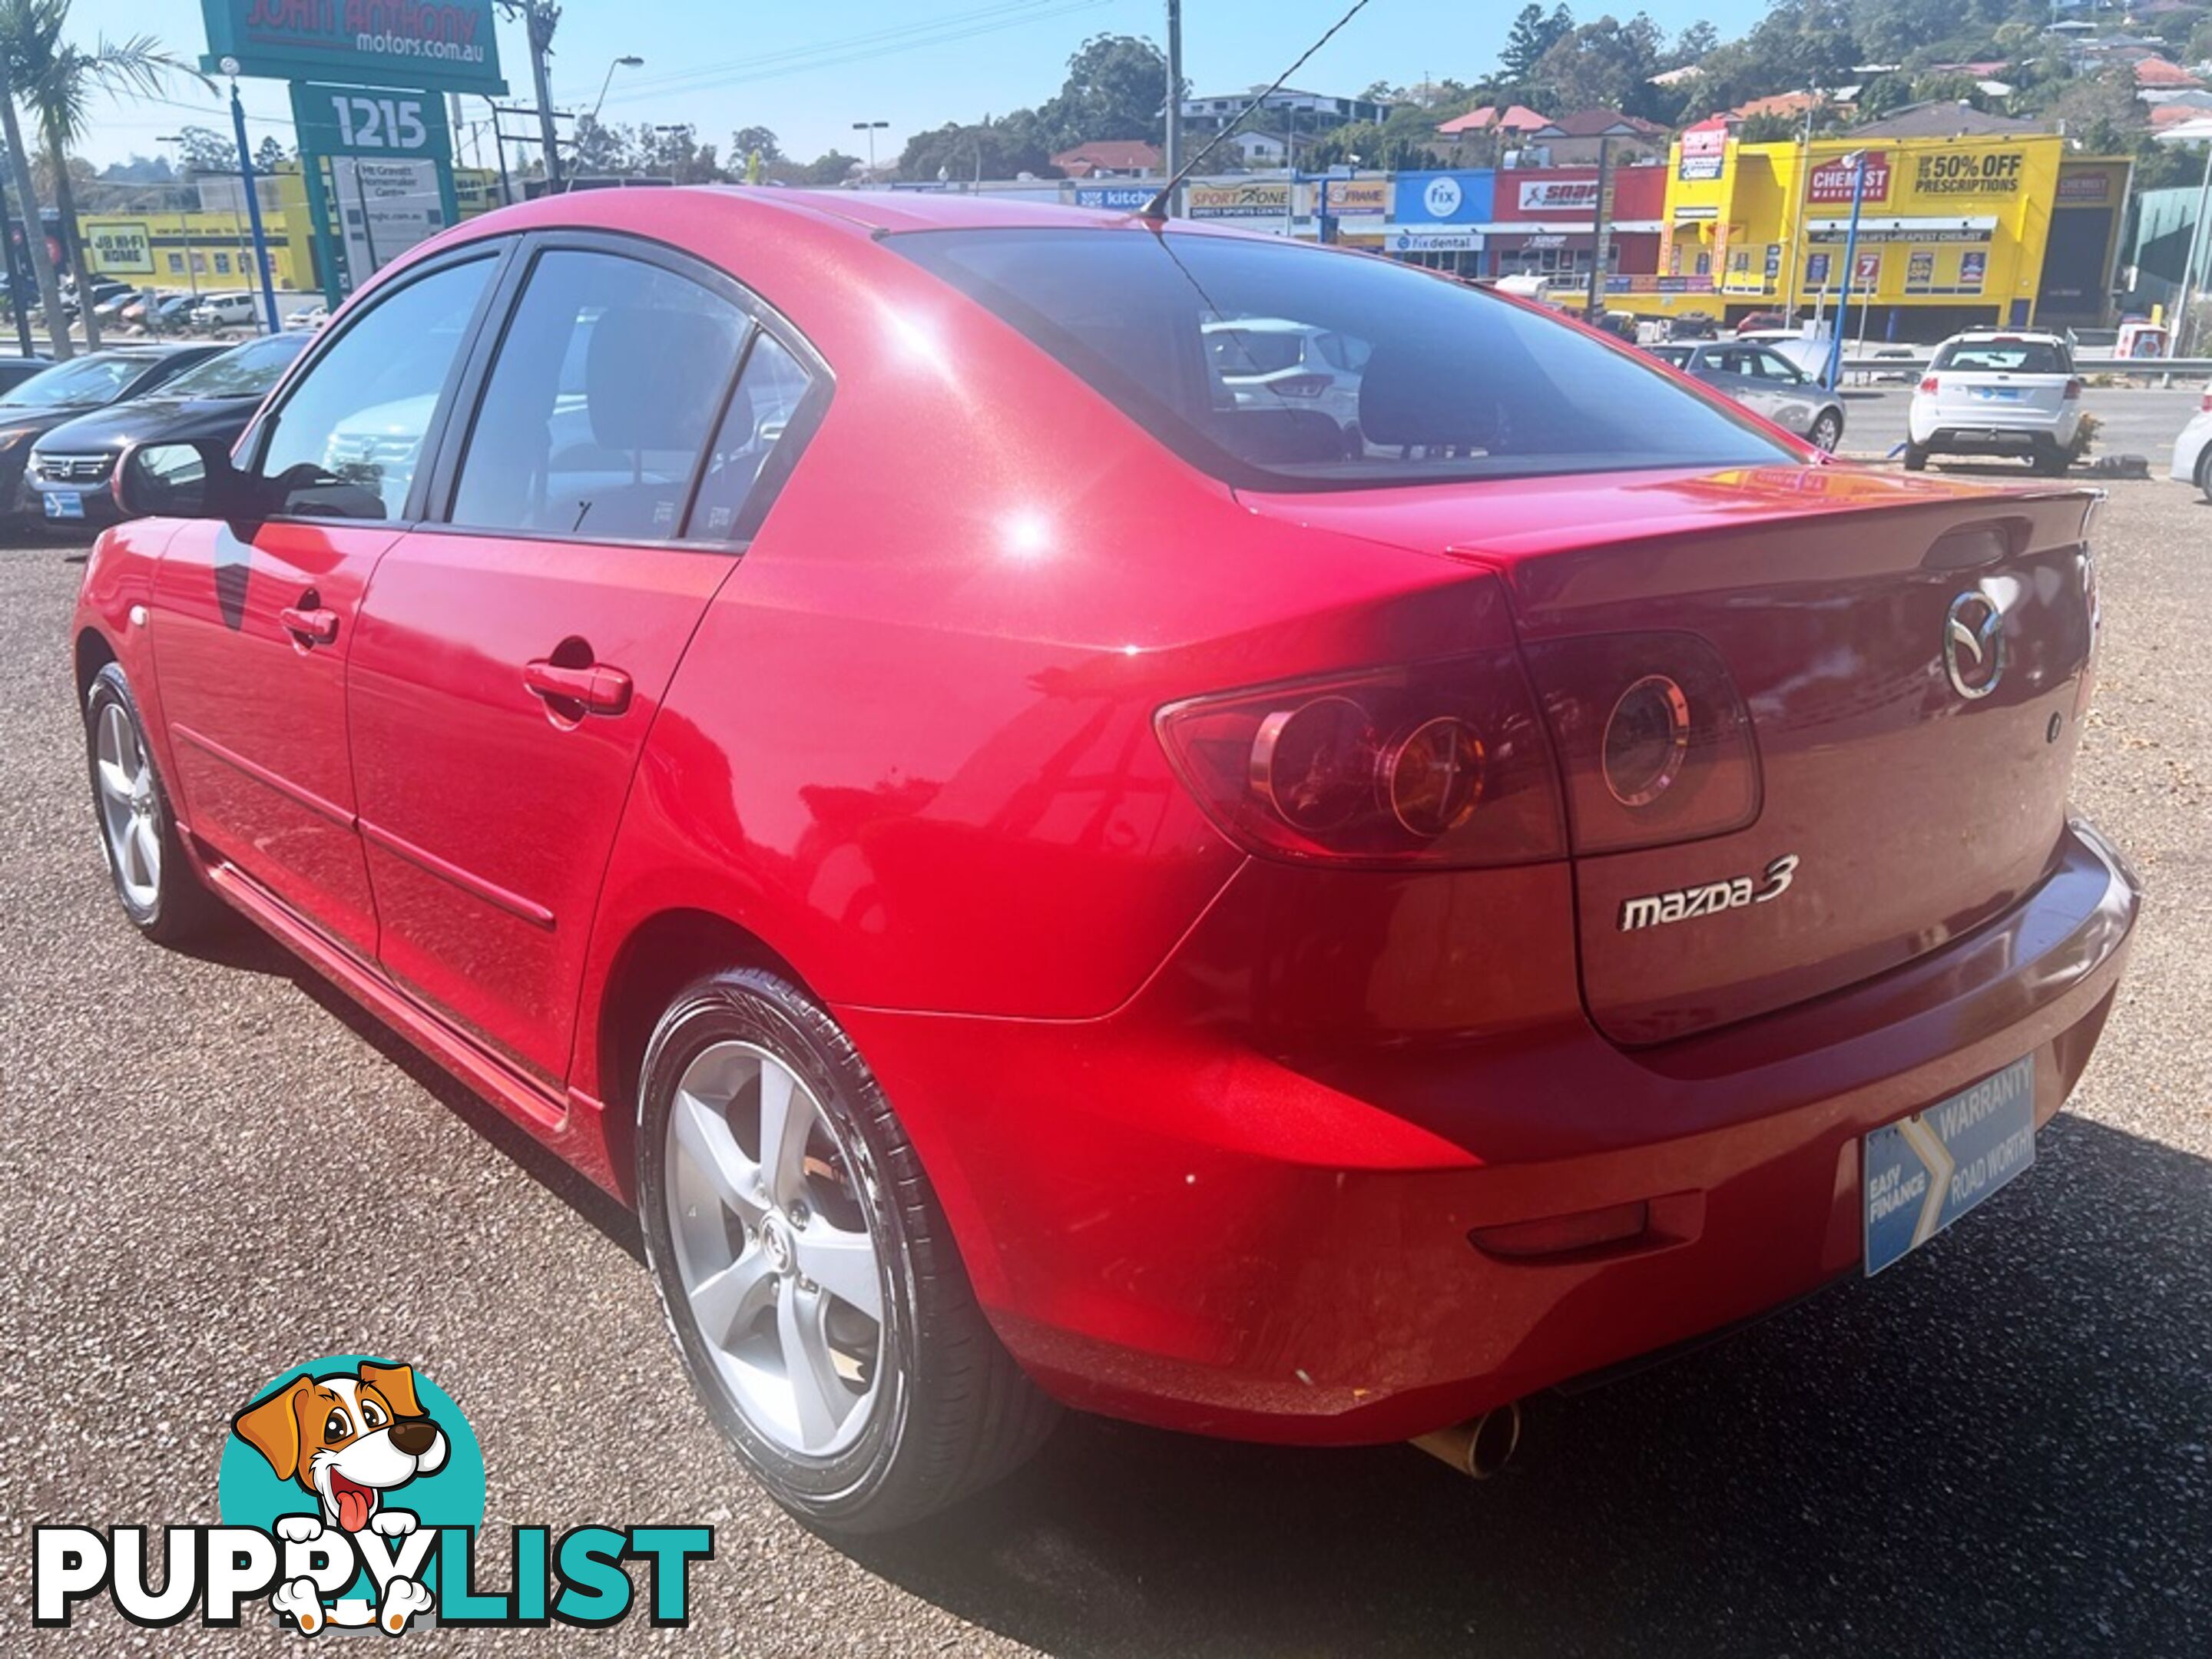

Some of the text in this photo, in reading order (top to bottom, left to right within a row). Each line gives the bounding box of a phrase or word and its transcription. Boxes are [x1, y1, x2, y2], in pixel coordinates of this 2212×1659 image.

[248, 0, 478, 43] JOHN ANTHONY
[356, 30, 484, 62] motors.com.au
[332, 96, 426, 147] 1215
[1813, 170, 1886, 187] CHEMST
[1934, 154, 2022, 177] 50% OFF
[1432, 186, 1453, 203] fix
[1916, 179, 2018, 192] PRESCRIPTIONS
[1861, 260, 1874, 276] 7
[1939, 1055, 2032, 1143] WARRANTY
[1869, 1164, 1902, 1200] EASY
[1869, 1171, 1926, 1224] FINANCE
[1951, 1157, 1986, 1206] ROAD
